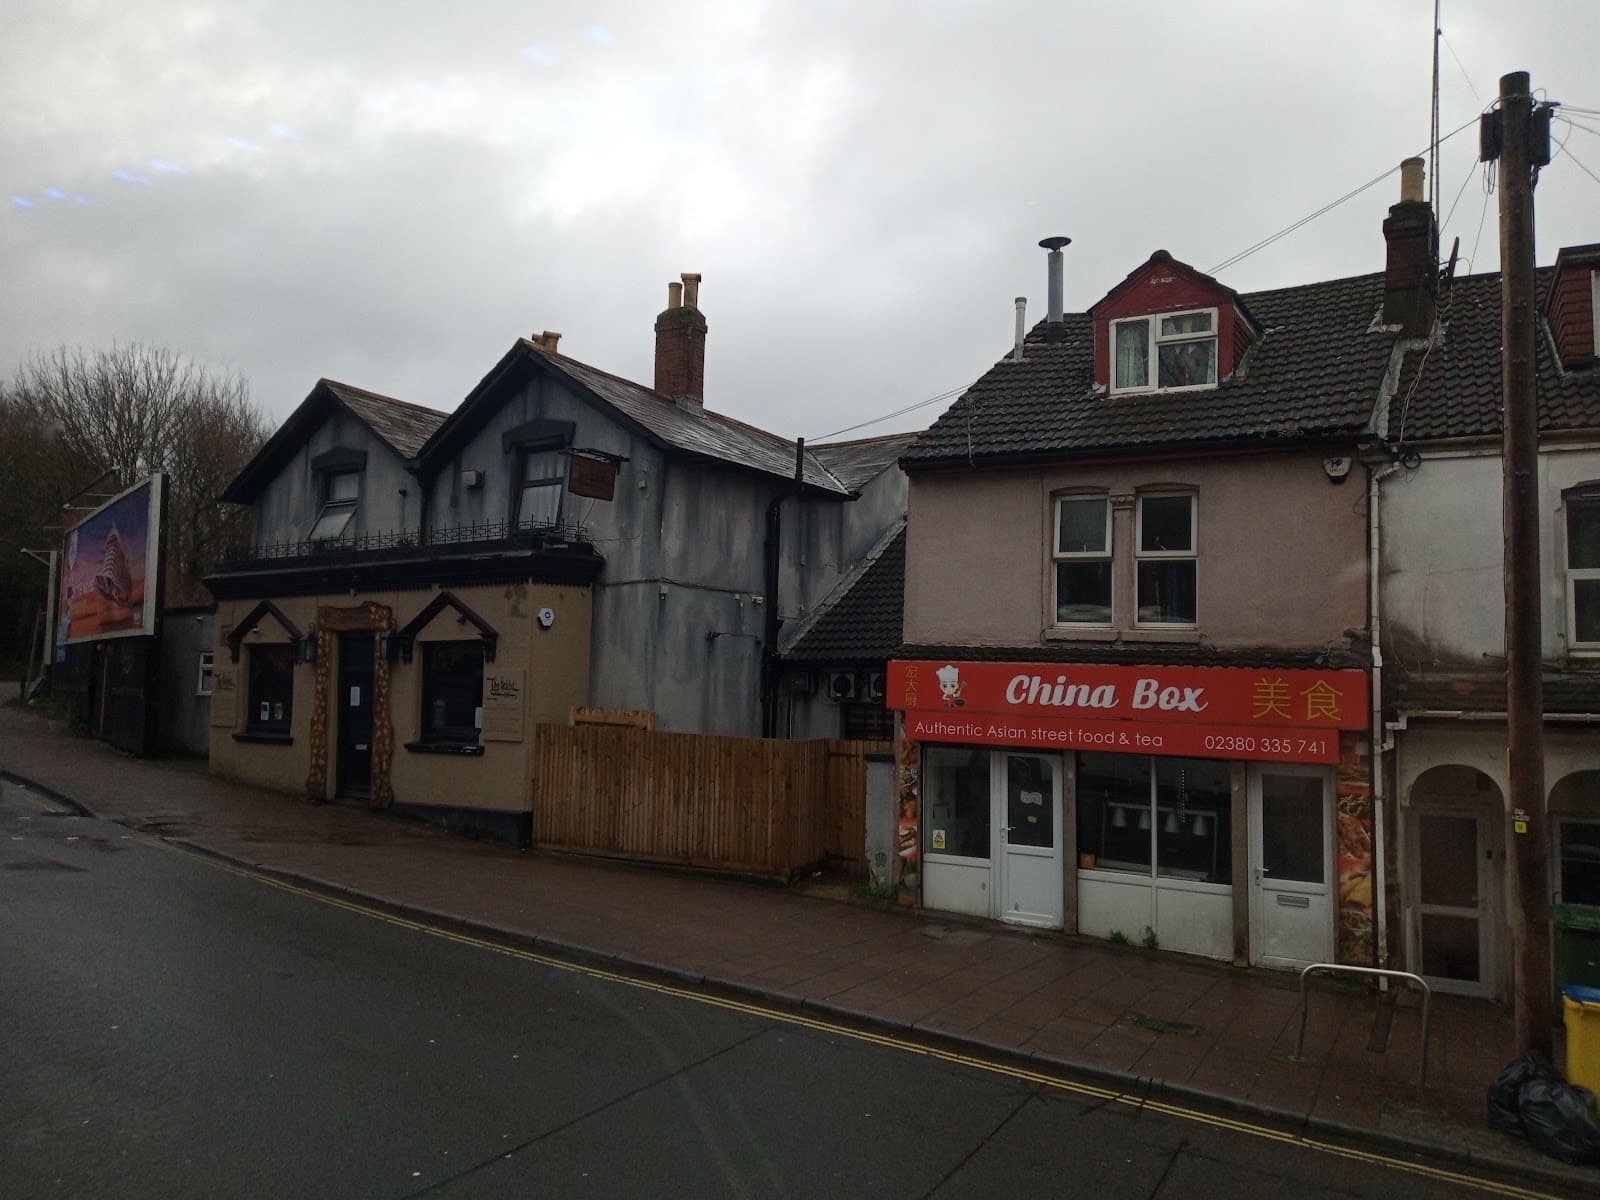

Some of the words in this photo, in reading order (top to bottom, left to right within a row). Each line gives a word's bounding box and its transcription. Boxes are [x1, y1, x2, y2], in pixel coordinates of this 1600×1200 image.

[1006, 674, 1120, 709] China
[1131, 678, 1209, 713] Box
[1252, 677, 1344, 721] 美食
[915, 721, 982, 736] Authentic
[987, 725, 1027, 738] Asian
[1031, 728, 1073, 742] street
[1079, 729, 1115, 744] food
[1119, 732, 1130, 745] &
[1136, 732, 1163, 747] tea
[1205, 735, 1256, 751] 02380
[1260, 738, 1292, 753] 335
[1298, 740, 1325, 755] 741
